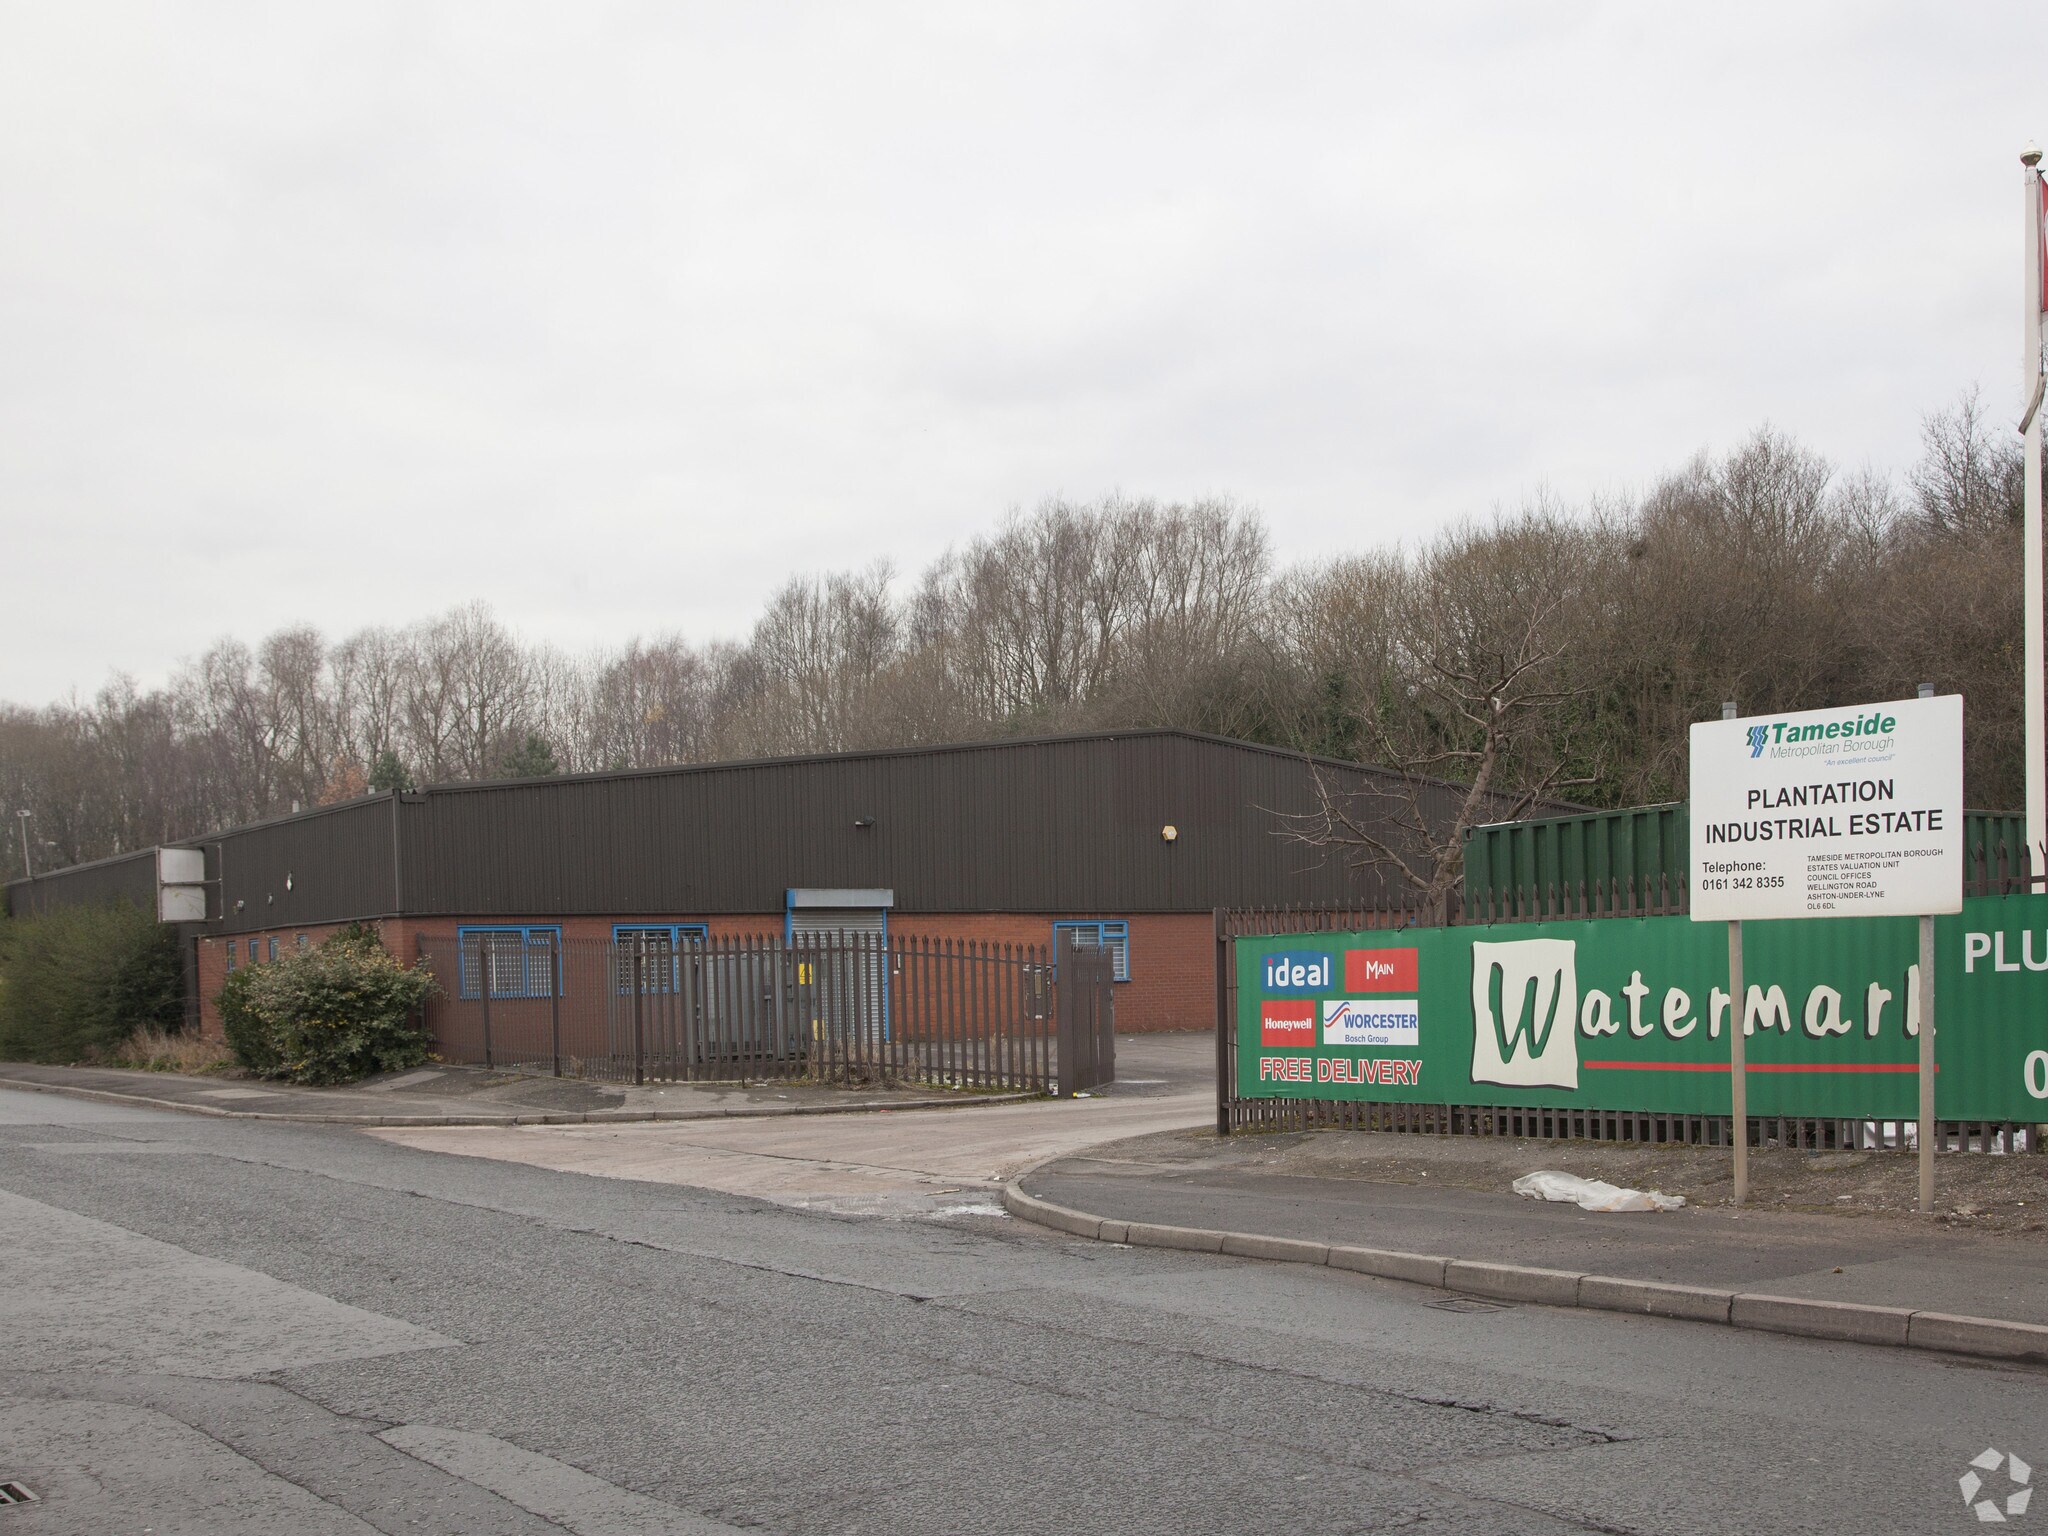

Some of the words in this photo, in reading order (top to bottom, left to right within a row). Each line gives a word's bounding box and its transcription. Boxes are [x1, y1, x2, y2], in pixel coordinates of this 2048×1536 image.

[1772, 712, 1896, 744] Tameside
[1769, 742, 1839, 760] Metropolitan
[1843, 736, 1895, 753] Borough
[1836, 756, 1867, 766] excellent
[1747, 779, 1894, 810] PLANTATION
[1706, 816, 1842, 844] INDUSTRIAL
[1849, 809, 1943, 836] ESTATE
[1807, 854, 1843, 862] TAMESIDE
[1844, 850, 1902, 860] METROPOLITAN
[1903, 848, 1943, 858] BOROUGH
[1702, 860, 1766, 875] Telephone:
[1807, 864, 1838, 872] ESTATES
[1840, 861, 1881, 870] VALUATION
[1882, 860, 1900, 868] UNIT
[1702, 878, 1728, 891] 0161
[1732, 877, 1753, 890] 342
[1756, 876, 1785, 889] 8355
[1807, 874, 1839, 882] COUNCIL
[1840, 872, 1872, 880] OFFICES
[1807, 882, 1854, 890] WELLINGTON
[1855, 881, 1878, 889] ROAD
[1807, 891, 1885, 900] ASHTON-UNDER-LYNE
[1807, 902, 1821, 910] OL6
[1822, 902, 1836, 910] 6DL
[1267, 956, 1329, 987] ideal
[1265, 1017, 1312, 1032] Honeywell
[1344, 1013, 1418, 1029] WORCESTER
[1345, 1034, 1366, 1043] Bosch
[1367, 1034, 1389, 1044] Group
[1260, 1057, 1312, 1081] FREE
[1317, 1058, 1423, 1085] DELIVERY
